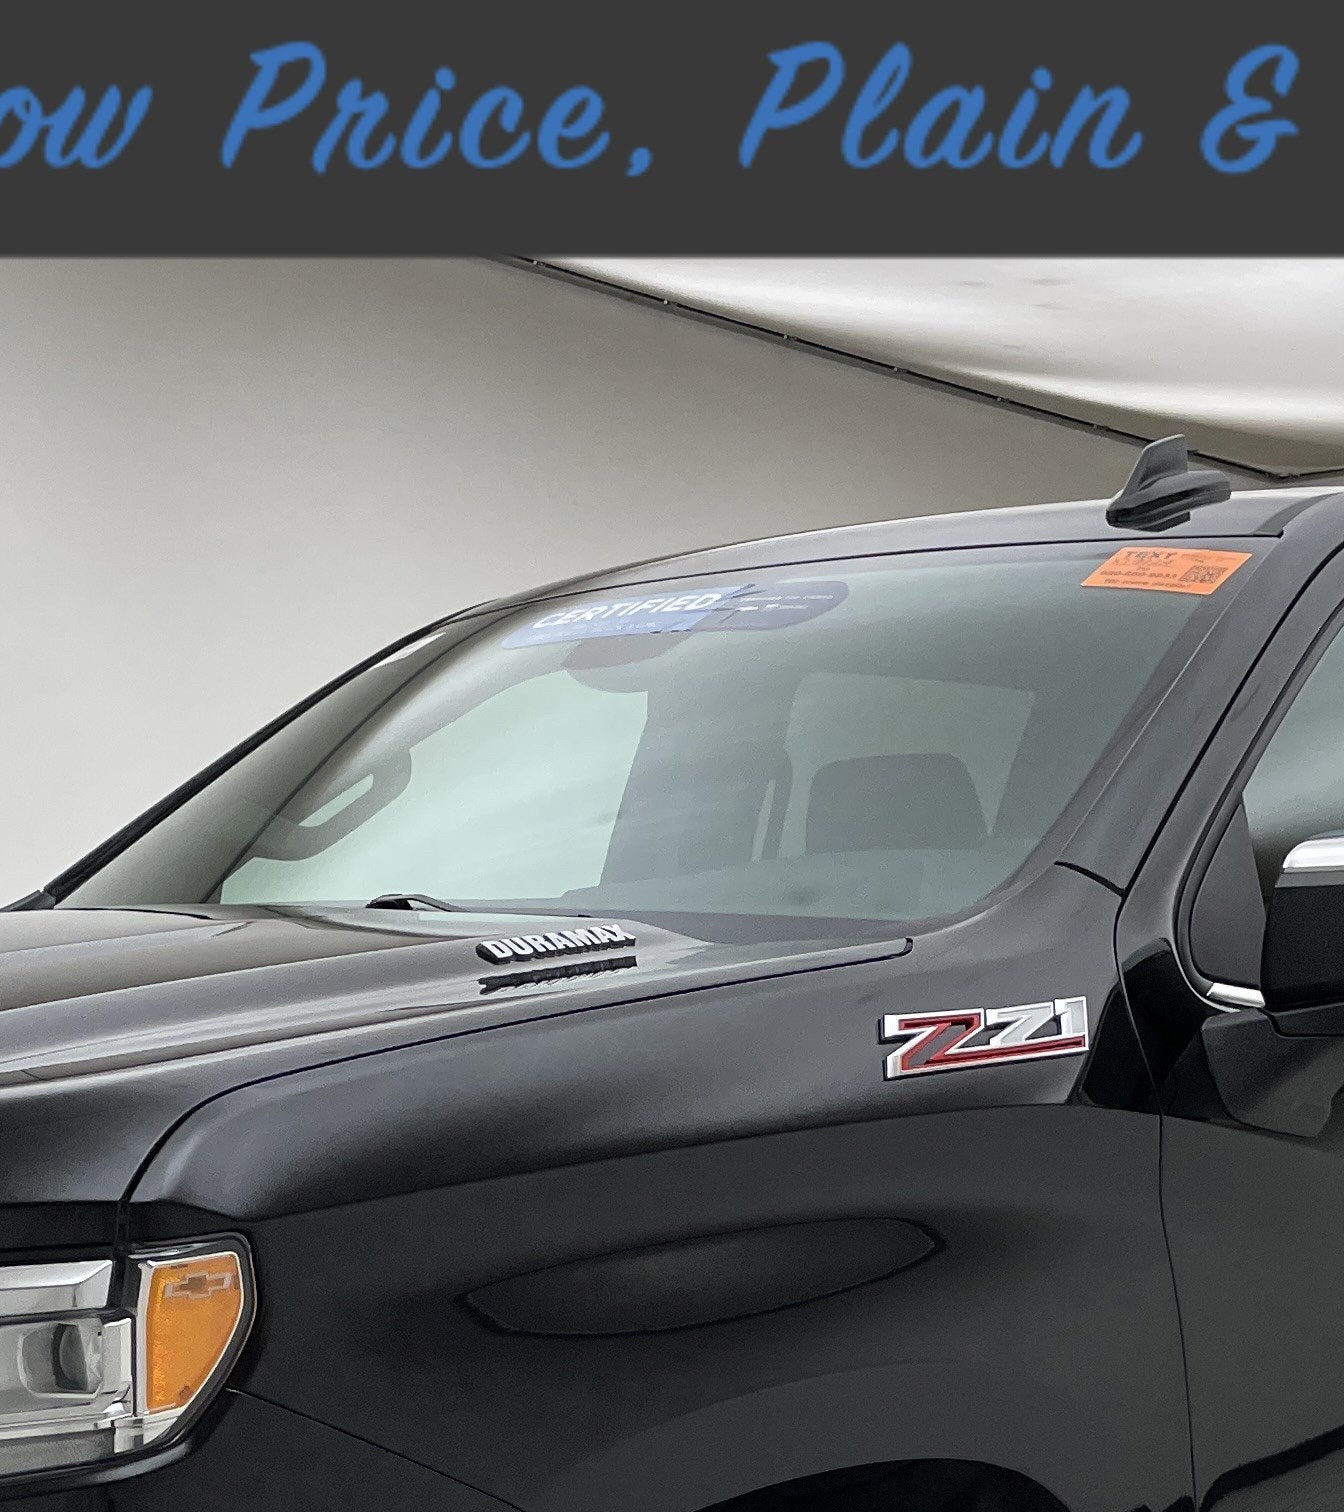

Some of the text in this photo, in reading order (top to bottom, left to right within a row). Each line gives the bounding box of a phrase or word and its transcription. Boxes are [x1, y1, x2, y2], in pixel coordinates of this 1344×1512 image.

[532, 593, 722, 629] CERTIFIED
[477, 924, 636, 963] DURAMAX
[879, 996, 1089, 1080] Z71
